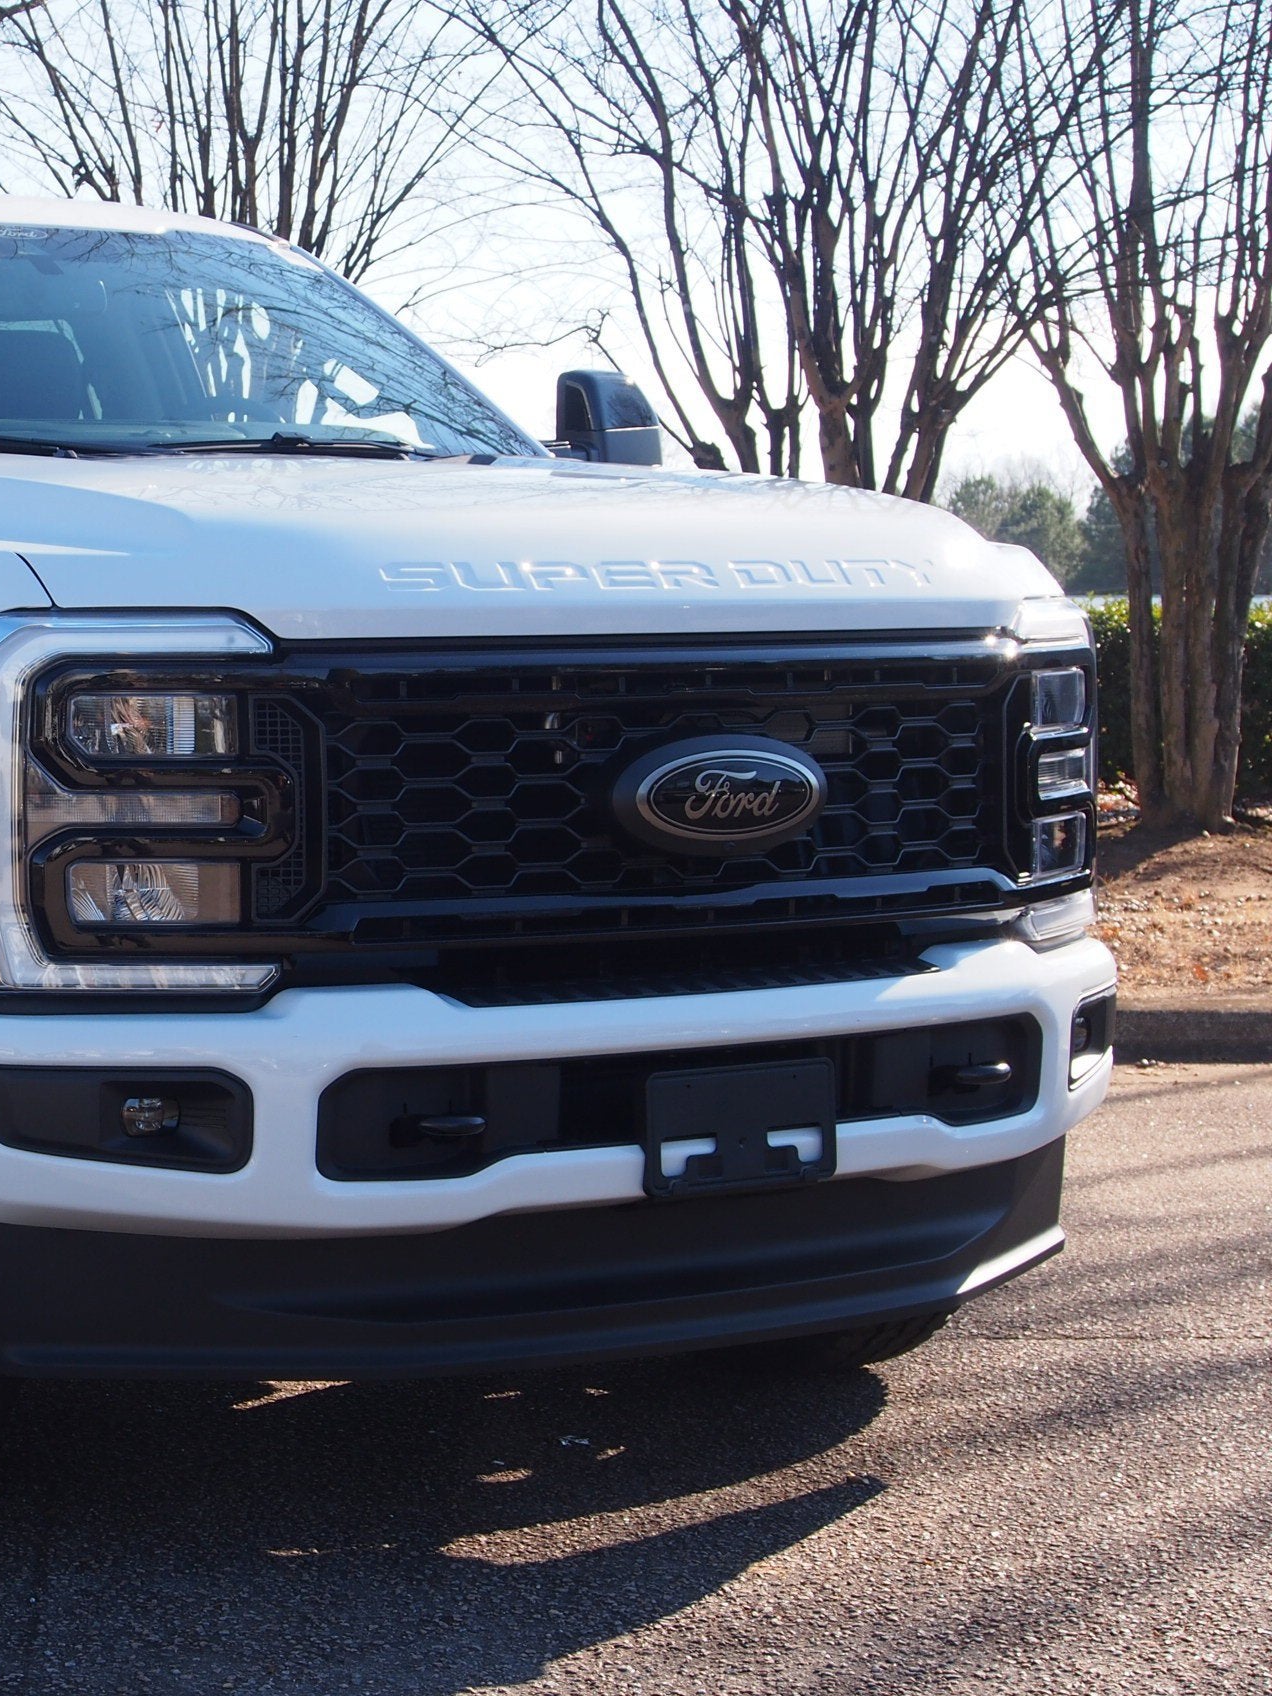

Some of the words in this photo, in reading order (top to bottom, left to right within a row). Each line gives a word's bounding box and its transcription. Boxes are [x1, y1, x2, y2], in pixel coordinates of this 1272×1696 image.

[379, 561, 719, 591] SUPER
[728, 559, 934, 588] DUTY
[684, 769, 781, 820] Ford
